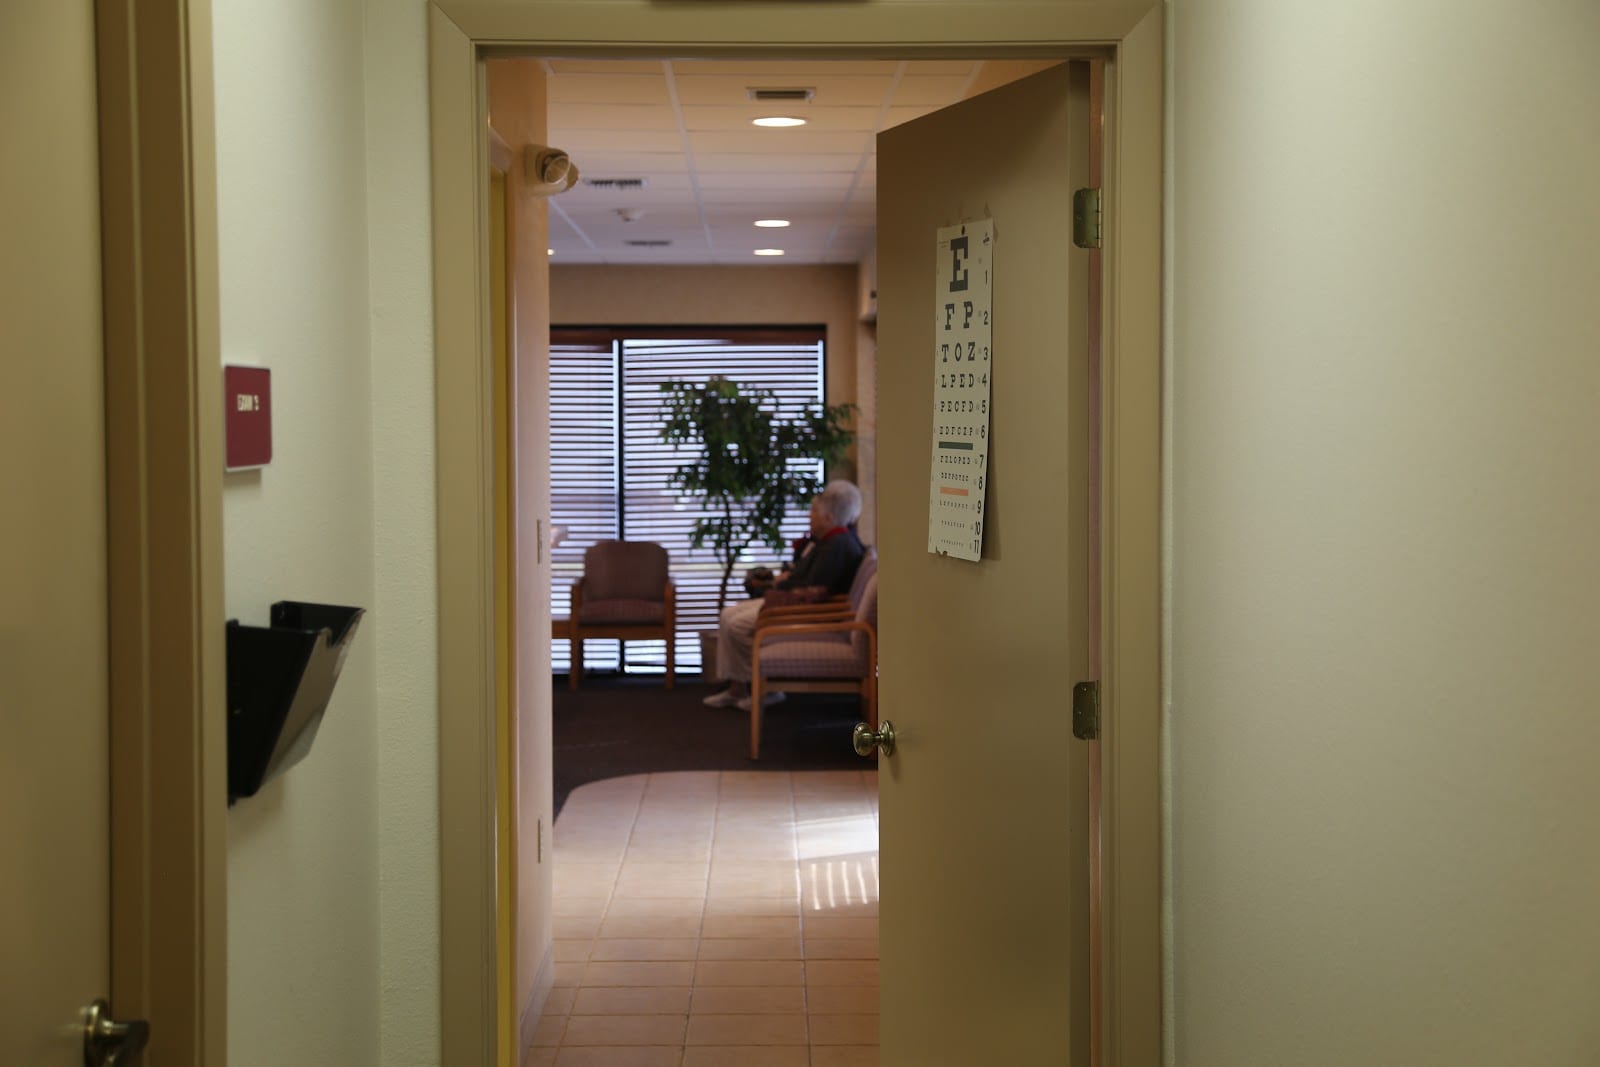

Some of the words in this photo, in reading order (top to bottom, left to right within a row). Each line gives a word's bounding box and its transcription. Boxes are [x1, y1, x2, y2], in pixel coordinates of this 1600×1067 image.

[950, 236, 969, 293] E
[983, 310, 990, 326] 2
[941, 341, 976, 363] TOZ
[983, 346, 989, 361] 3
[941, 373, 975, 389] LPED
[981, 372, 988, 388] 4
[981, 399, 987, 414] 5
[980, 424, 986, 440] 6
[979, 454, 985, 469] 7
[978, 476, 984, 491] 8
[976, 499, 983, 515] 9
